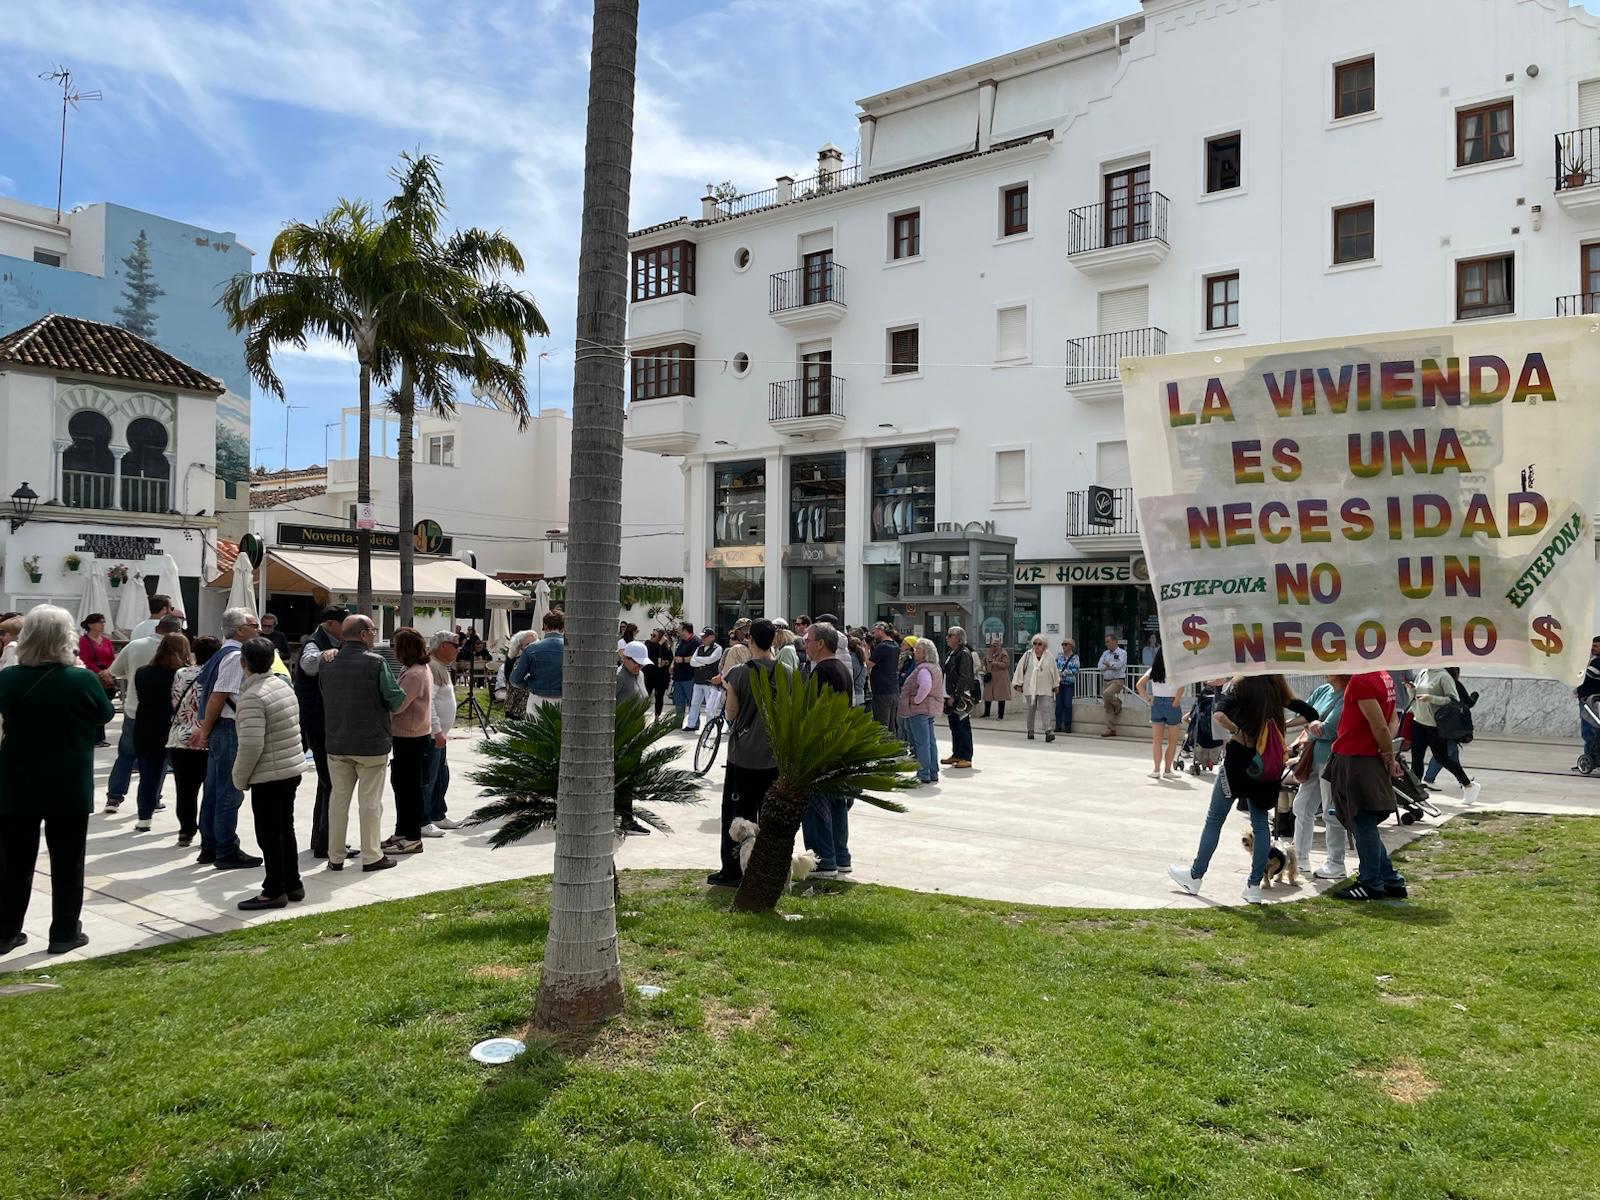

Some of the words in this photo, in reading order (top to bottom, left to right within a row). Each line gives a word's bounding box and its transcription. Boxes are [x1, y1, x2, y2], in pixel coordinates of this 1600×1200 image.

[1167, 378, 1236, 428] LA
[1262, 352, 1557, 418] VIVIENDA
[1231, 438, 1303, 484] ES
[1348, 428, 1473, 478] UNA
[302, 529, 353, 543] Noventa
[1186, 491, 1549, 550] NECESIDAD
[1055, 566, 1130, 581] HOUSE
[1274, 562, 1342, 605] NO
[1397, 555, 1481, 599] UN
[1505, 512, 1581, 609] ESTEPONA
[1160, 577, 1267, 601] ESTEPONA
[1181, 613, 1210, 655] $
[1232, 615, 1498, 663] NEGOCIO
[1530, 615, 1564, 657] $
